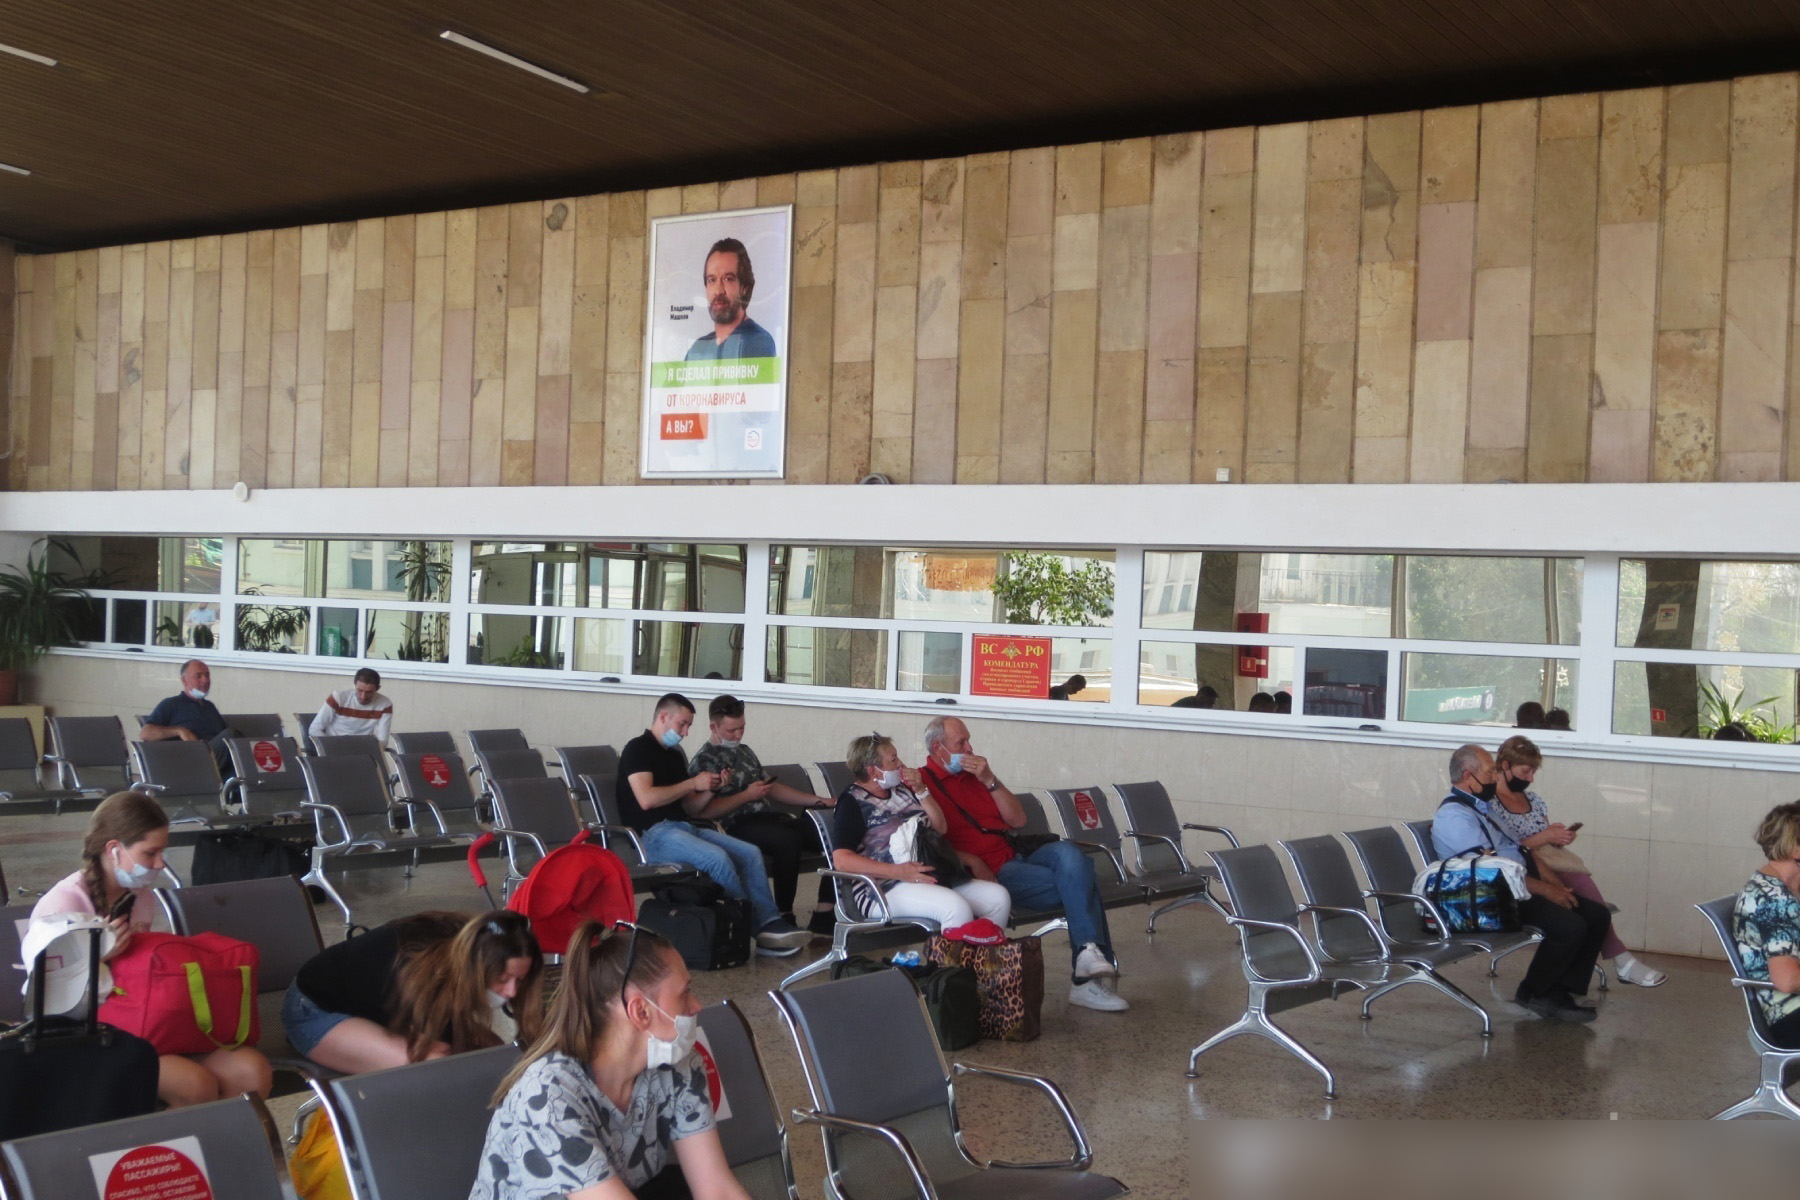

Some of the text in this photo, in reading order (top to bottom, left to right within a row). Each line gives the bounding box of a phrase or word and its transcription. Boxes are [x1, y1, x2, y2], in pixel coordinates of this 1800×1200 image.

[670, 304, 694, 312] Владимир
[667, 364, 760, 381] Я СДЕЛАЛ ПРИВИВКУ
[666, 391, 747, 408] ОТ КОРОНАВИРУСА
[666, 419, 694, 434] А ВЫ?
[980, 643, 1044, 656] ВС РФ
[983, 660, 1039, 669] КОМЕНДАТУРА
[120, 1151, 177, 1171] УВАЖАЕМЫЕ
